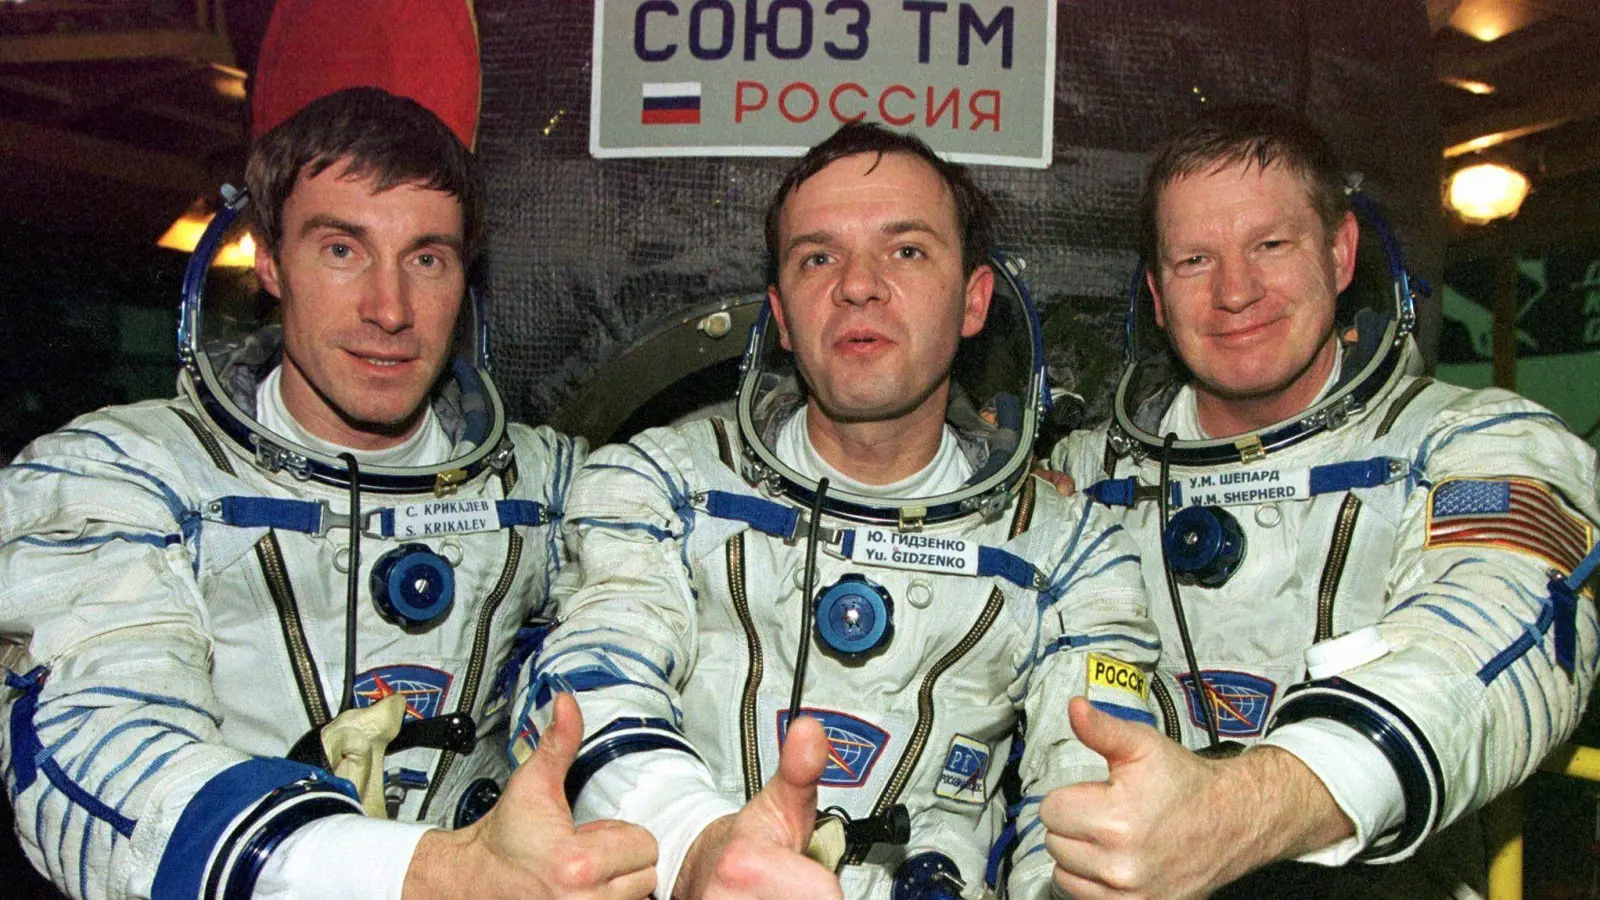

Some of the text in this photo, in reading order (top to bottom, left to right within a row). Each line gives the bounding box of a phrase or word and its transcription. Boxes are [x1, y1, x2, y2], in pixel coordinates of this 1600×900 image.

[634, 0, 1015, 69] СОЮЗ ТМ
[735, 81, 1001, 133] РОССИЯ
[1189, 470, 1280, 489] У.М. ШЕПАРД
[1190, 485, 1296, 507] W.M. SHEPHERD
[405, 500, 489, 518] С. КРИКАЛЕВ
[405, 518, 487, 537] S. KRIKALEV
[867, 530, 966, 552] Ю. ГИДЗЕНКО
[866, 549, 966, 569] Yu. GIDZENKO
